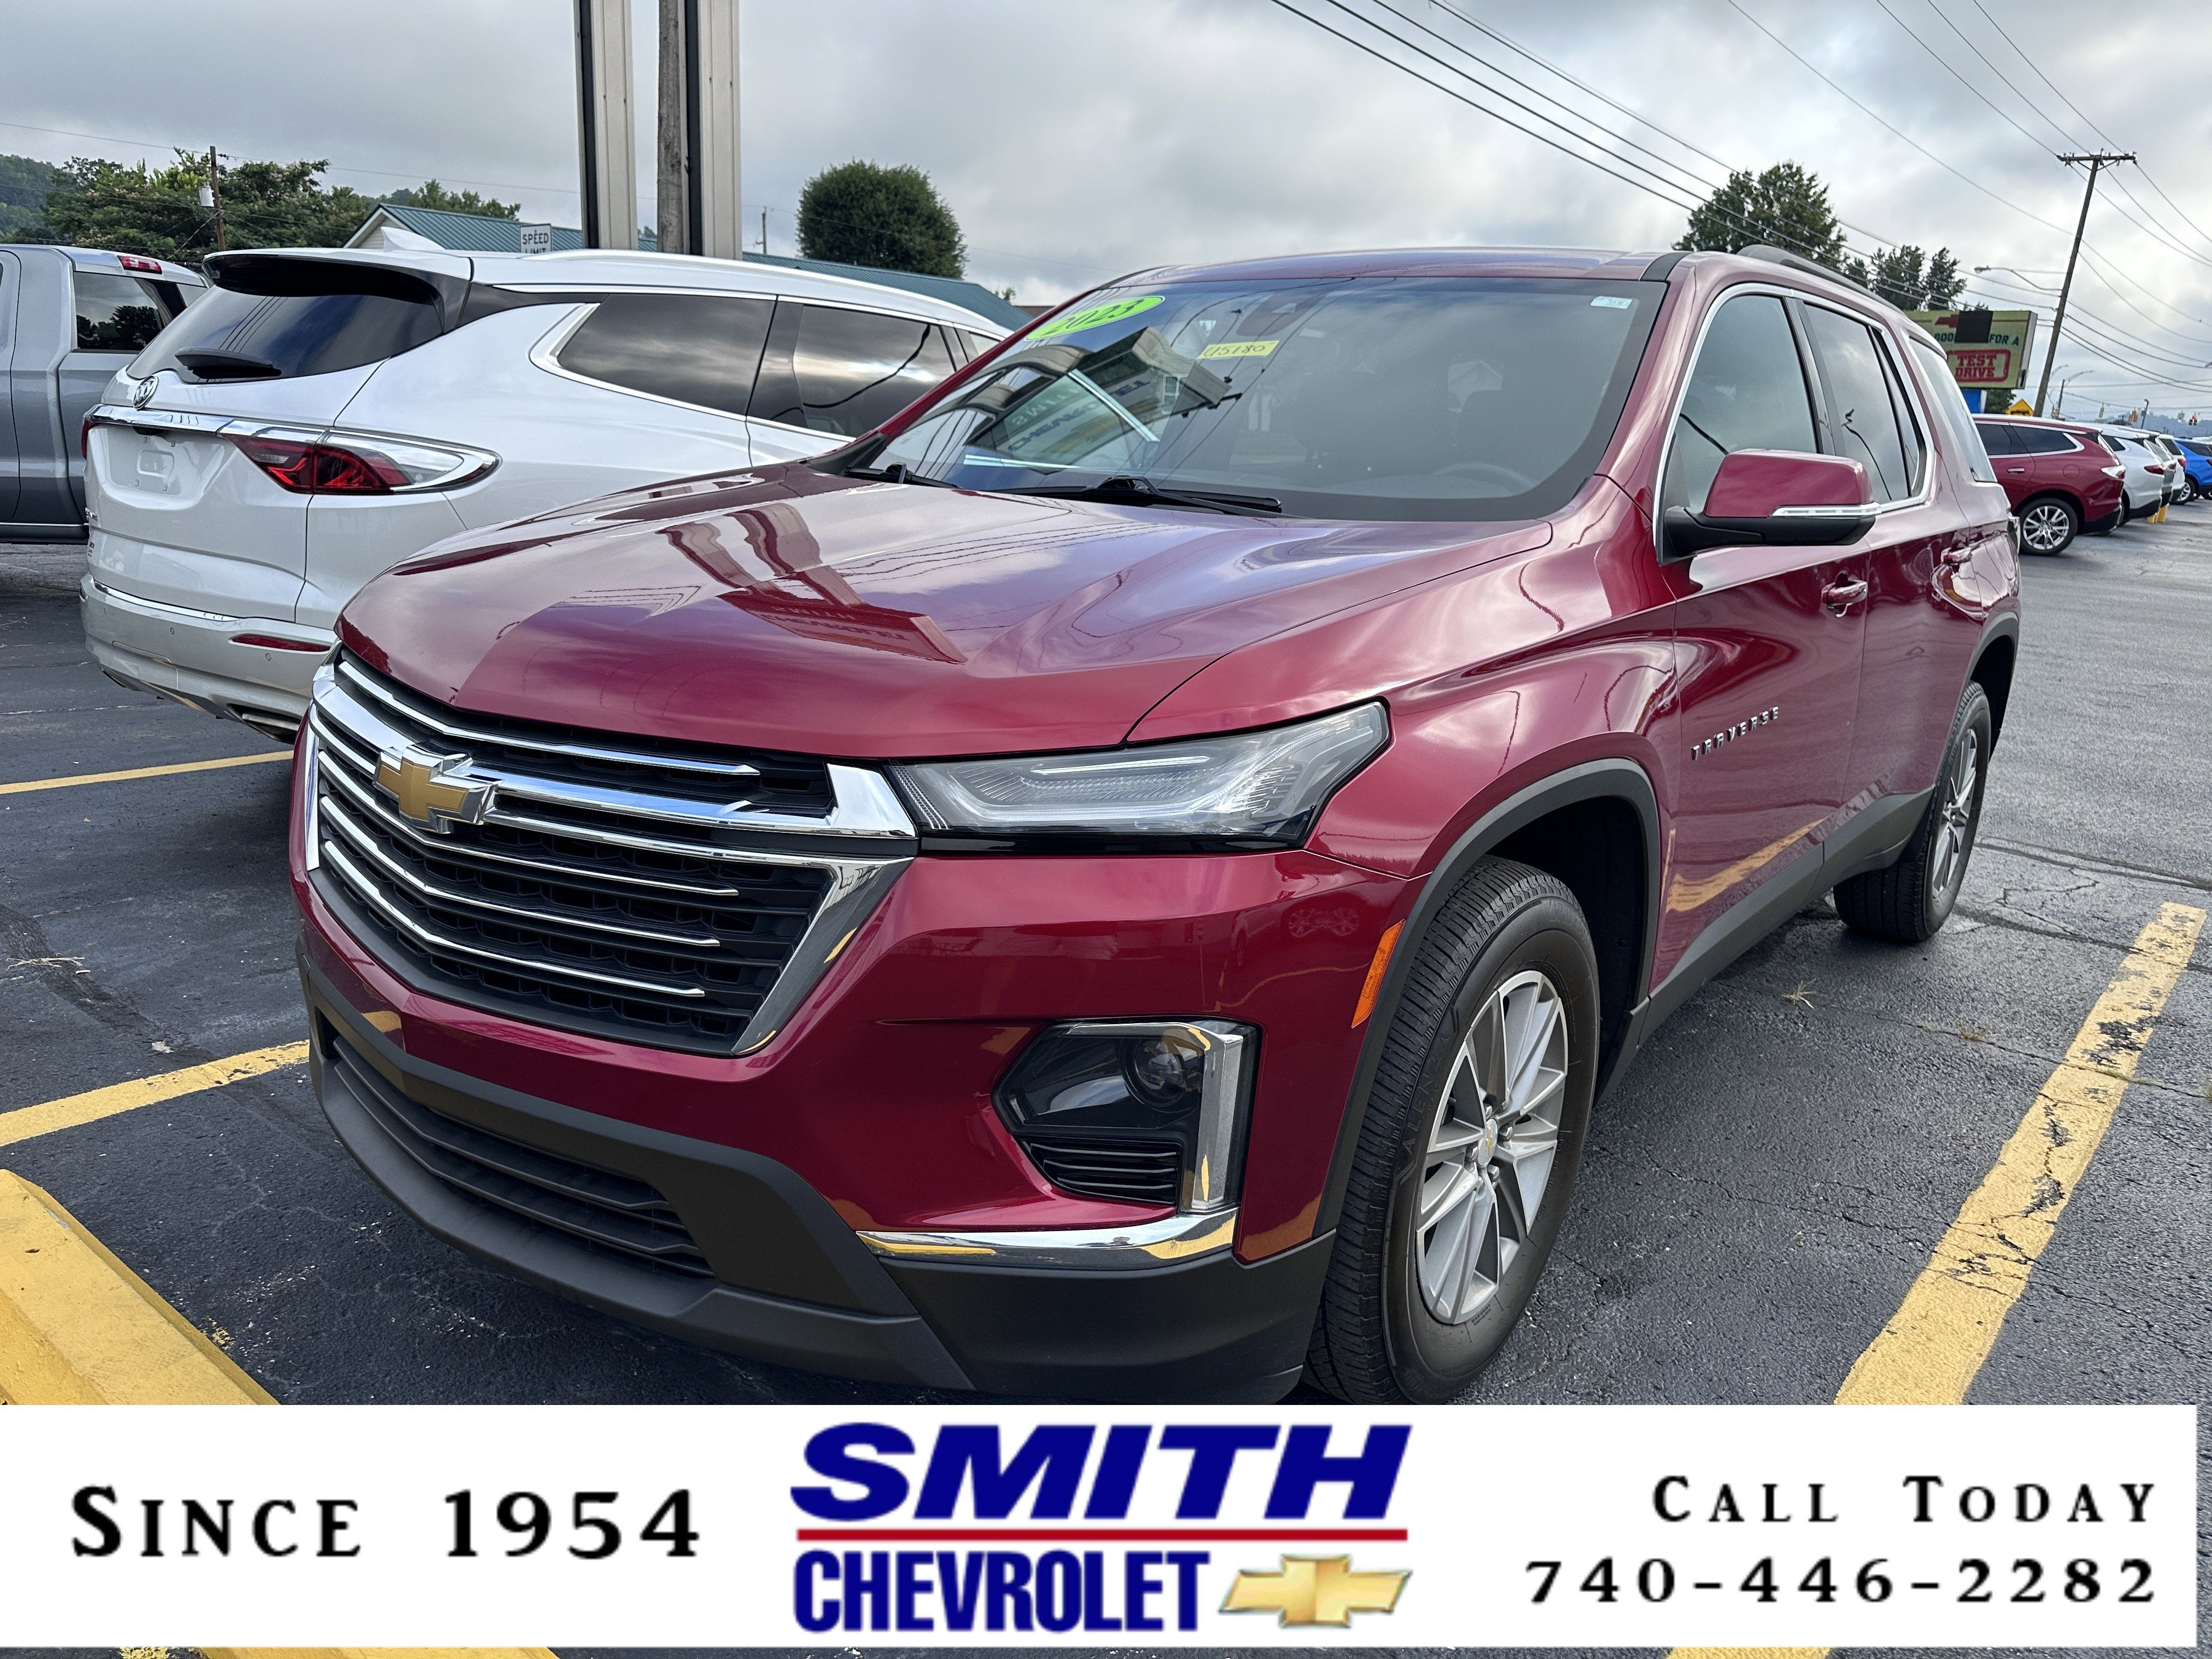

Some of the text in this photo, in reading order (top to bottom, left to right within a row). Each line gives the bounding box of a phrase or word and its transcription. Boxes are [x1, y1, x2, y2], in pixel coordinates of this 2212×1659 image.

[522, 233, 549, 245] SPEED
[1989, 334, 2010, 344] FOR
[2011, 335, 2019, 346] A
[1957, 355, 1997, 366] TEST
[1955, 367, 1995, 379] DRIVE
[1691, 706, 1779, 760] TRAVERSE
